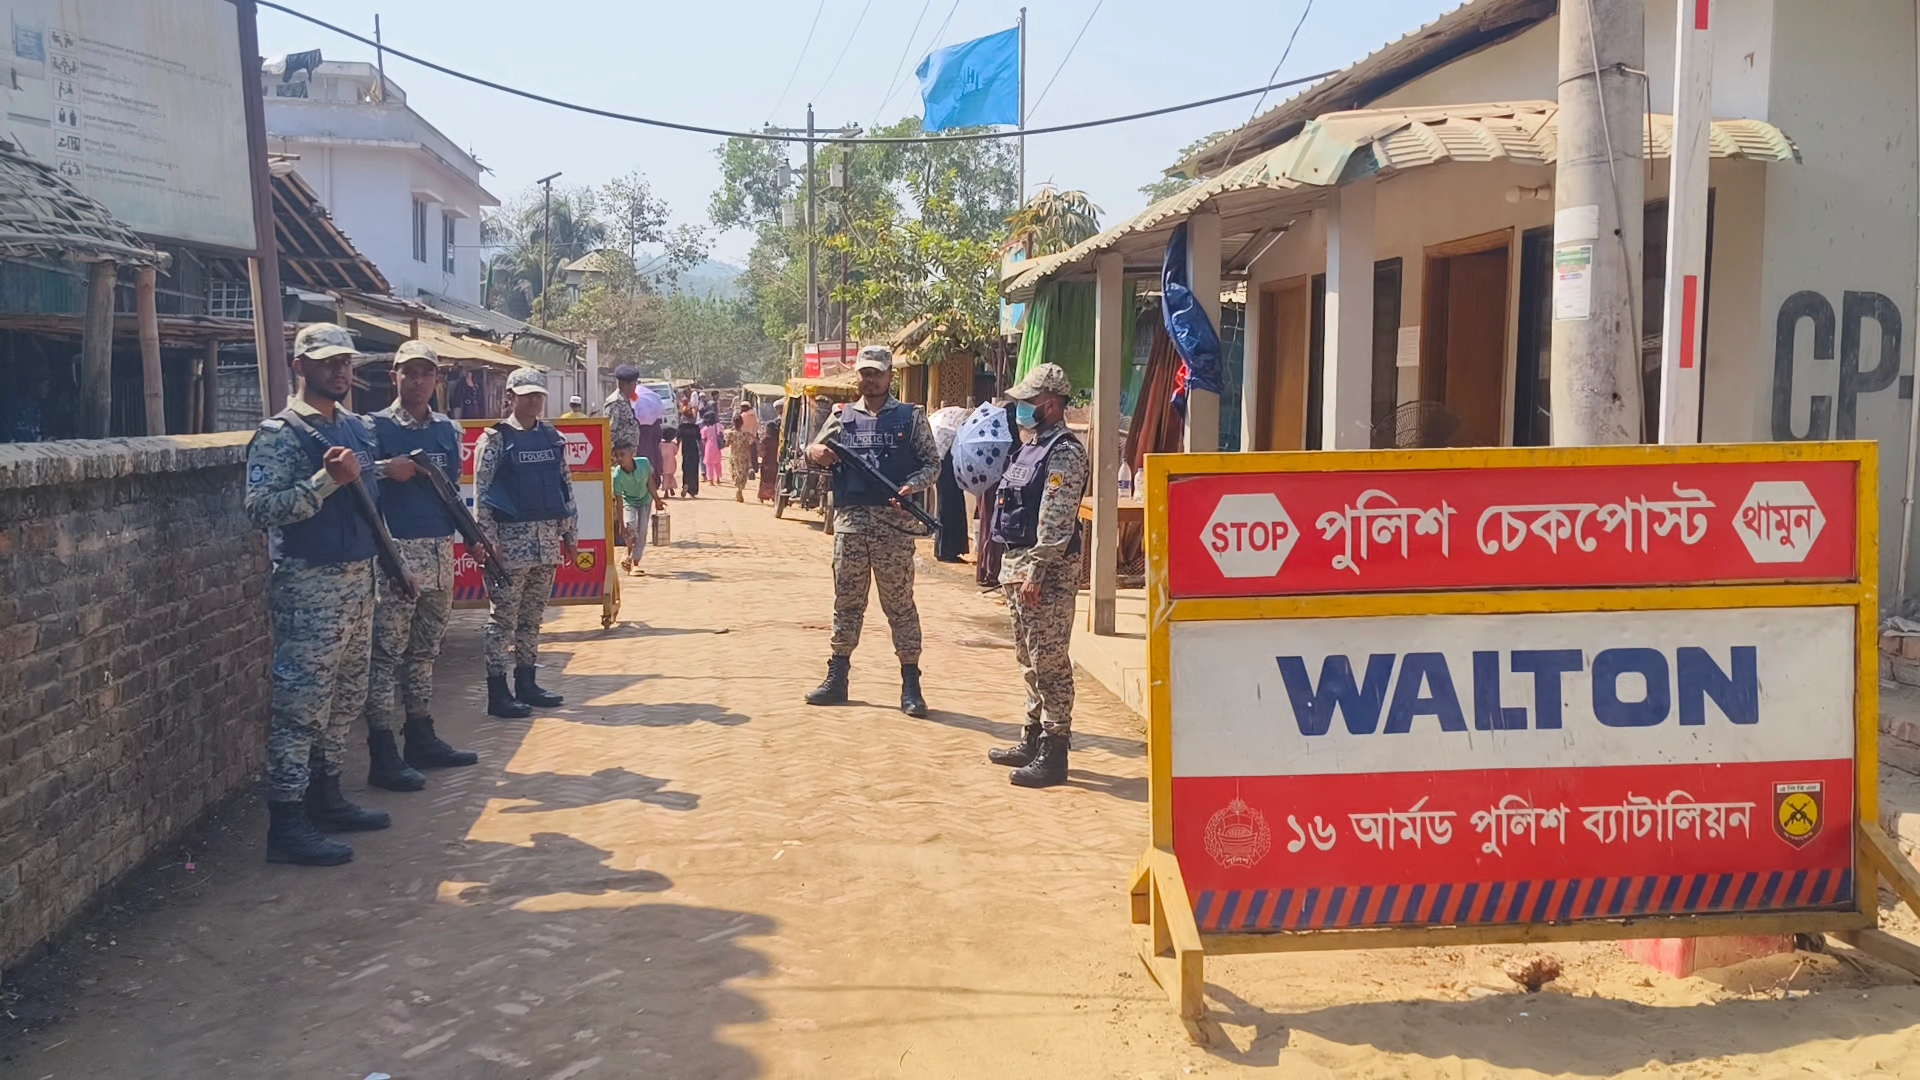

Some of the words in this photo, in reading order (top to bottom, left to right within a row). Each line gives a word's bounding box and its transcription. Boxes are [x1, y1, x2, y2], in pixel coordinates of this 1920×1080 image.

[522, 452, 550, 461] POLICE
[857, 435, 884, 443] POLIC
[1211, 521, 1289, 553] STOP
[1315, 489, 1457, 575] পুলিশ
[1477, 481, 1716, 555] চেকপোস্ট
[1742, 500, 1816, 550] থামুন
[1276, 647, 1758, 737] WALTON
[1287, 814, 1337, 853] ১৬
[1348, 796, 1457, 850] আর্মড
[1470, 795, 1571, 858] পুলিশ
[1580, 790, 1756, 843] ব্যাটালিয়ন
